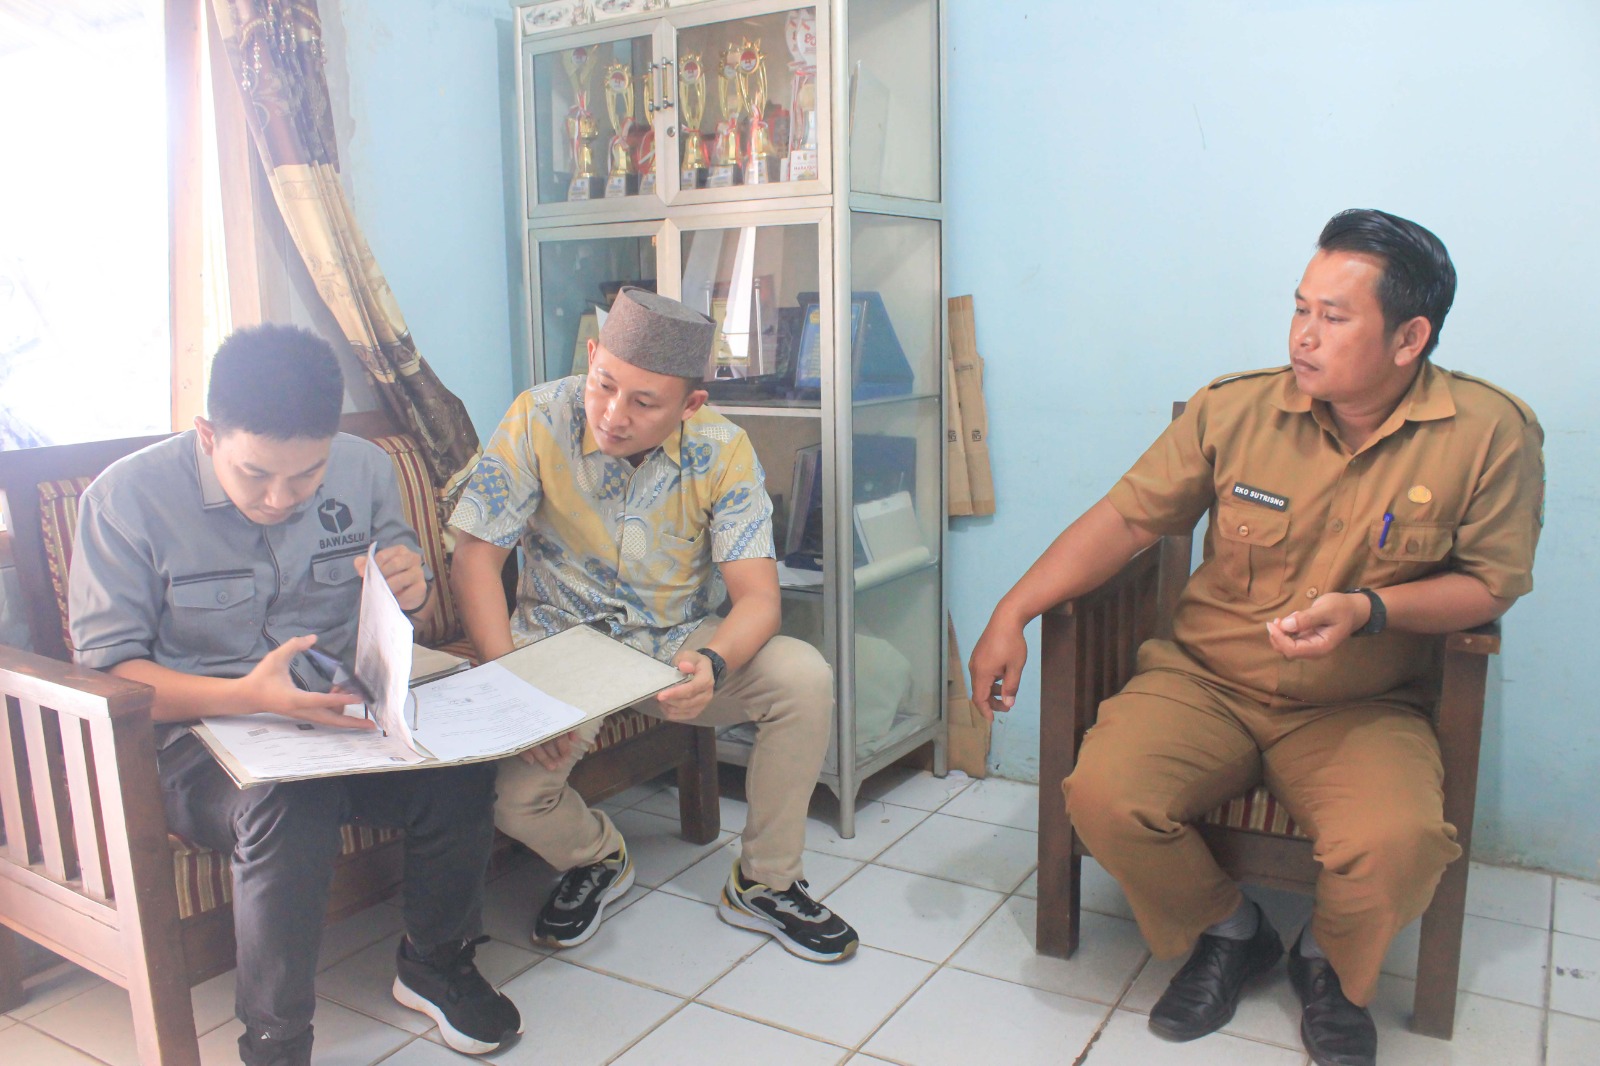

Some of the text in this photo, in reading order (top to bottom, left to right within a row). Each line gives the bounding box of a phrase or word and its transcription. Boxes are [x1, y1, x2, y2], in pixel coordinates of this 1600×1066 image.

[1235, 486, 1284, 506] EKO SUTRISNO
[320, 533, 364, 549] BAWASLU
